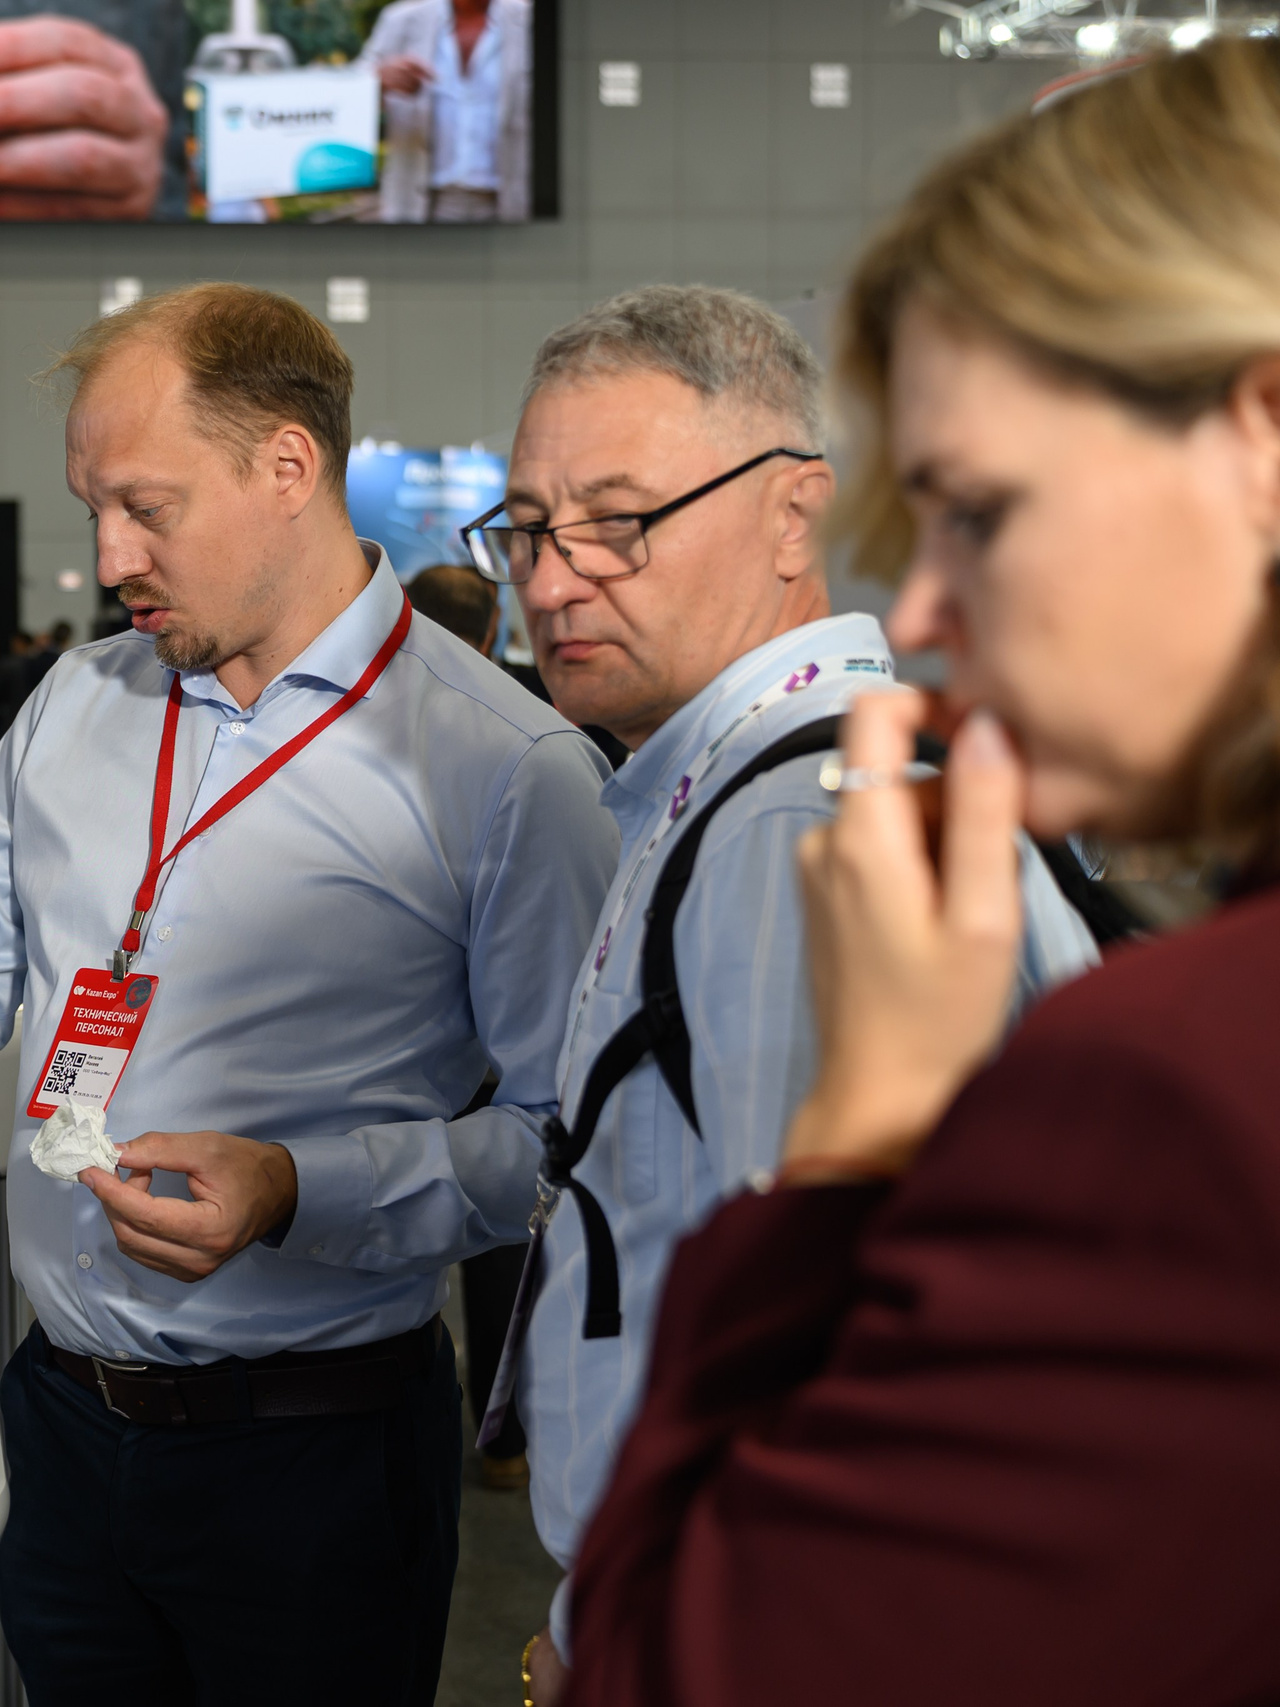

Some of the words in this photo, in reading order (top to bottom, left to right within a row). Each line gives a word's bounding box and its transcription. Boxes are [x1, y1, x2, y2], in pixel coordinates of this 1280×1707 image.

[86, 988, 102, 997] Kazan
[102, 990, 117, 1000] Expo
[73, 1007, 138, 1024] ТЕХНИЧЕСКИЙ
[74, 1022, 124, 1037] ПЕРСОНАЛ
